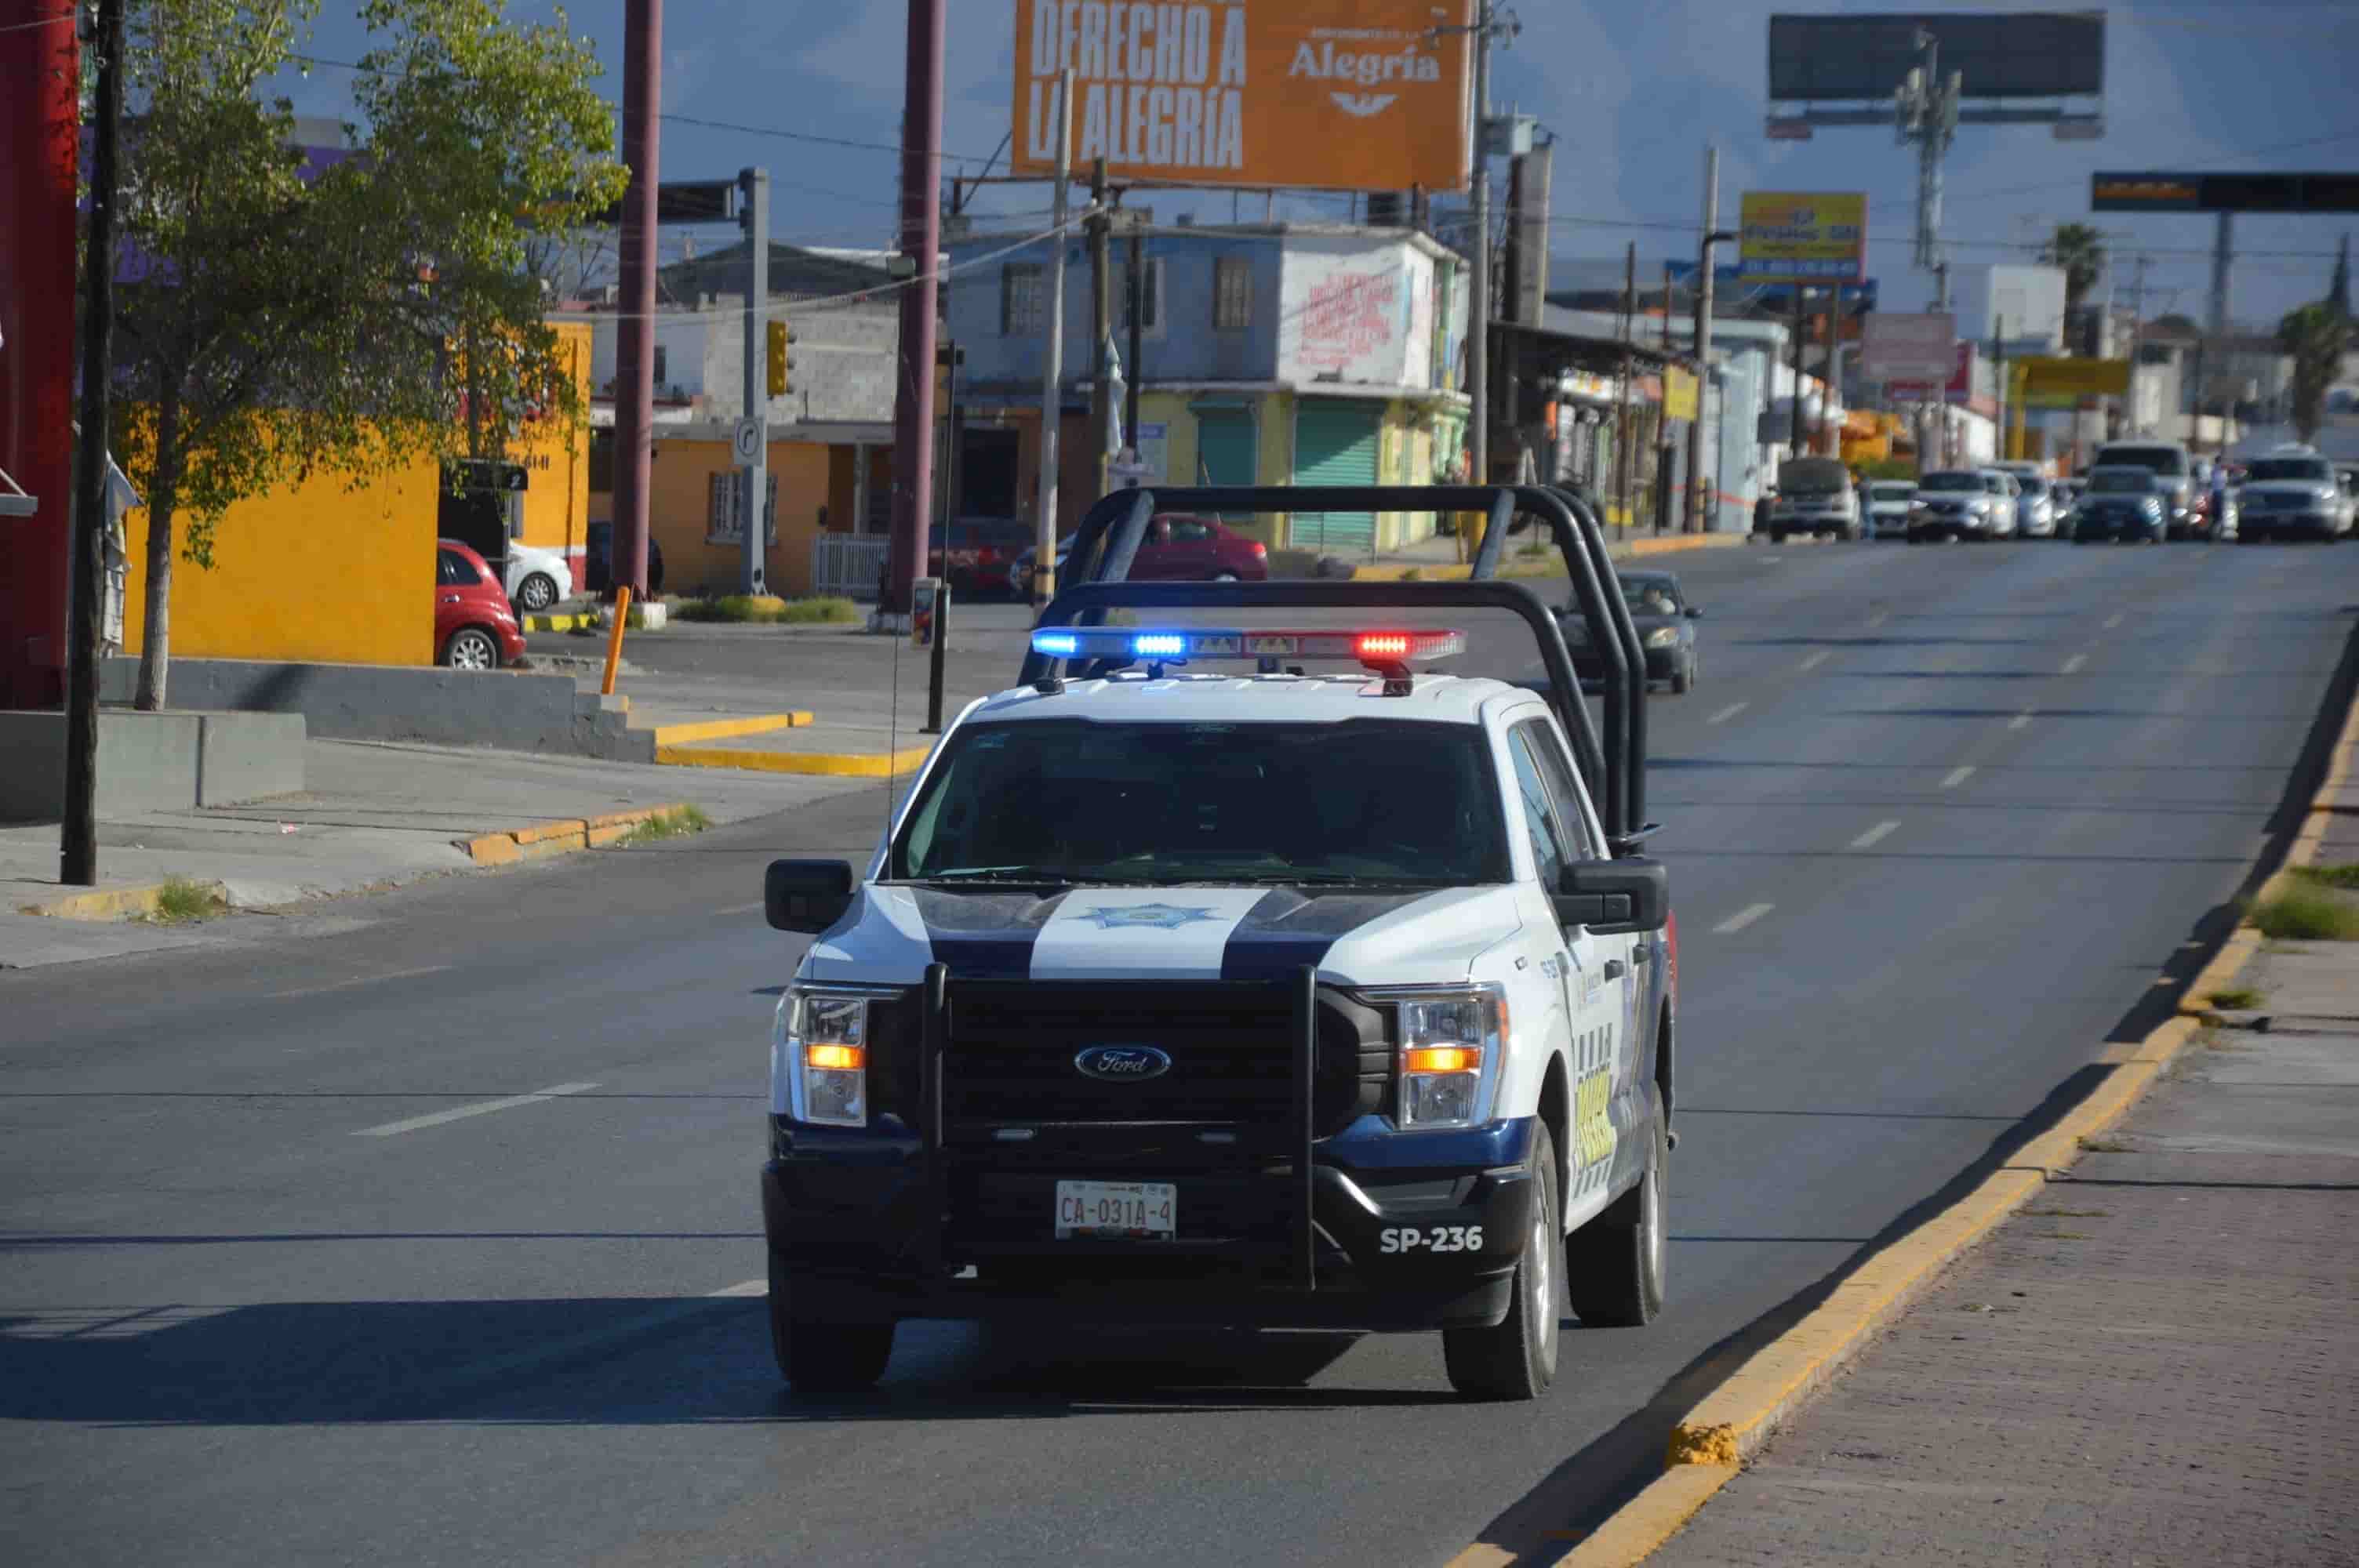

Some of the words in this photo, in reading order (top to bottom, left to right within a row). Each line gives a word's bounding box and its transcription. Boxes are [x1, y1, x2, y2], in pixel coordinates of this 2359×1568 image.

[1032, 0, 1210, 84] DERECHO
[1219, 6, 1246, 86] A
[1289, 41, 1440, 86] Alegría
[1080, 83, 1244, 169] ALEGRÍA
[1098, 1051, 1148, 1073] Ford
[1061, 1197, 1170, 1227] CA-031A-4
[1380, 1225, 1483, 1253] SP-236
